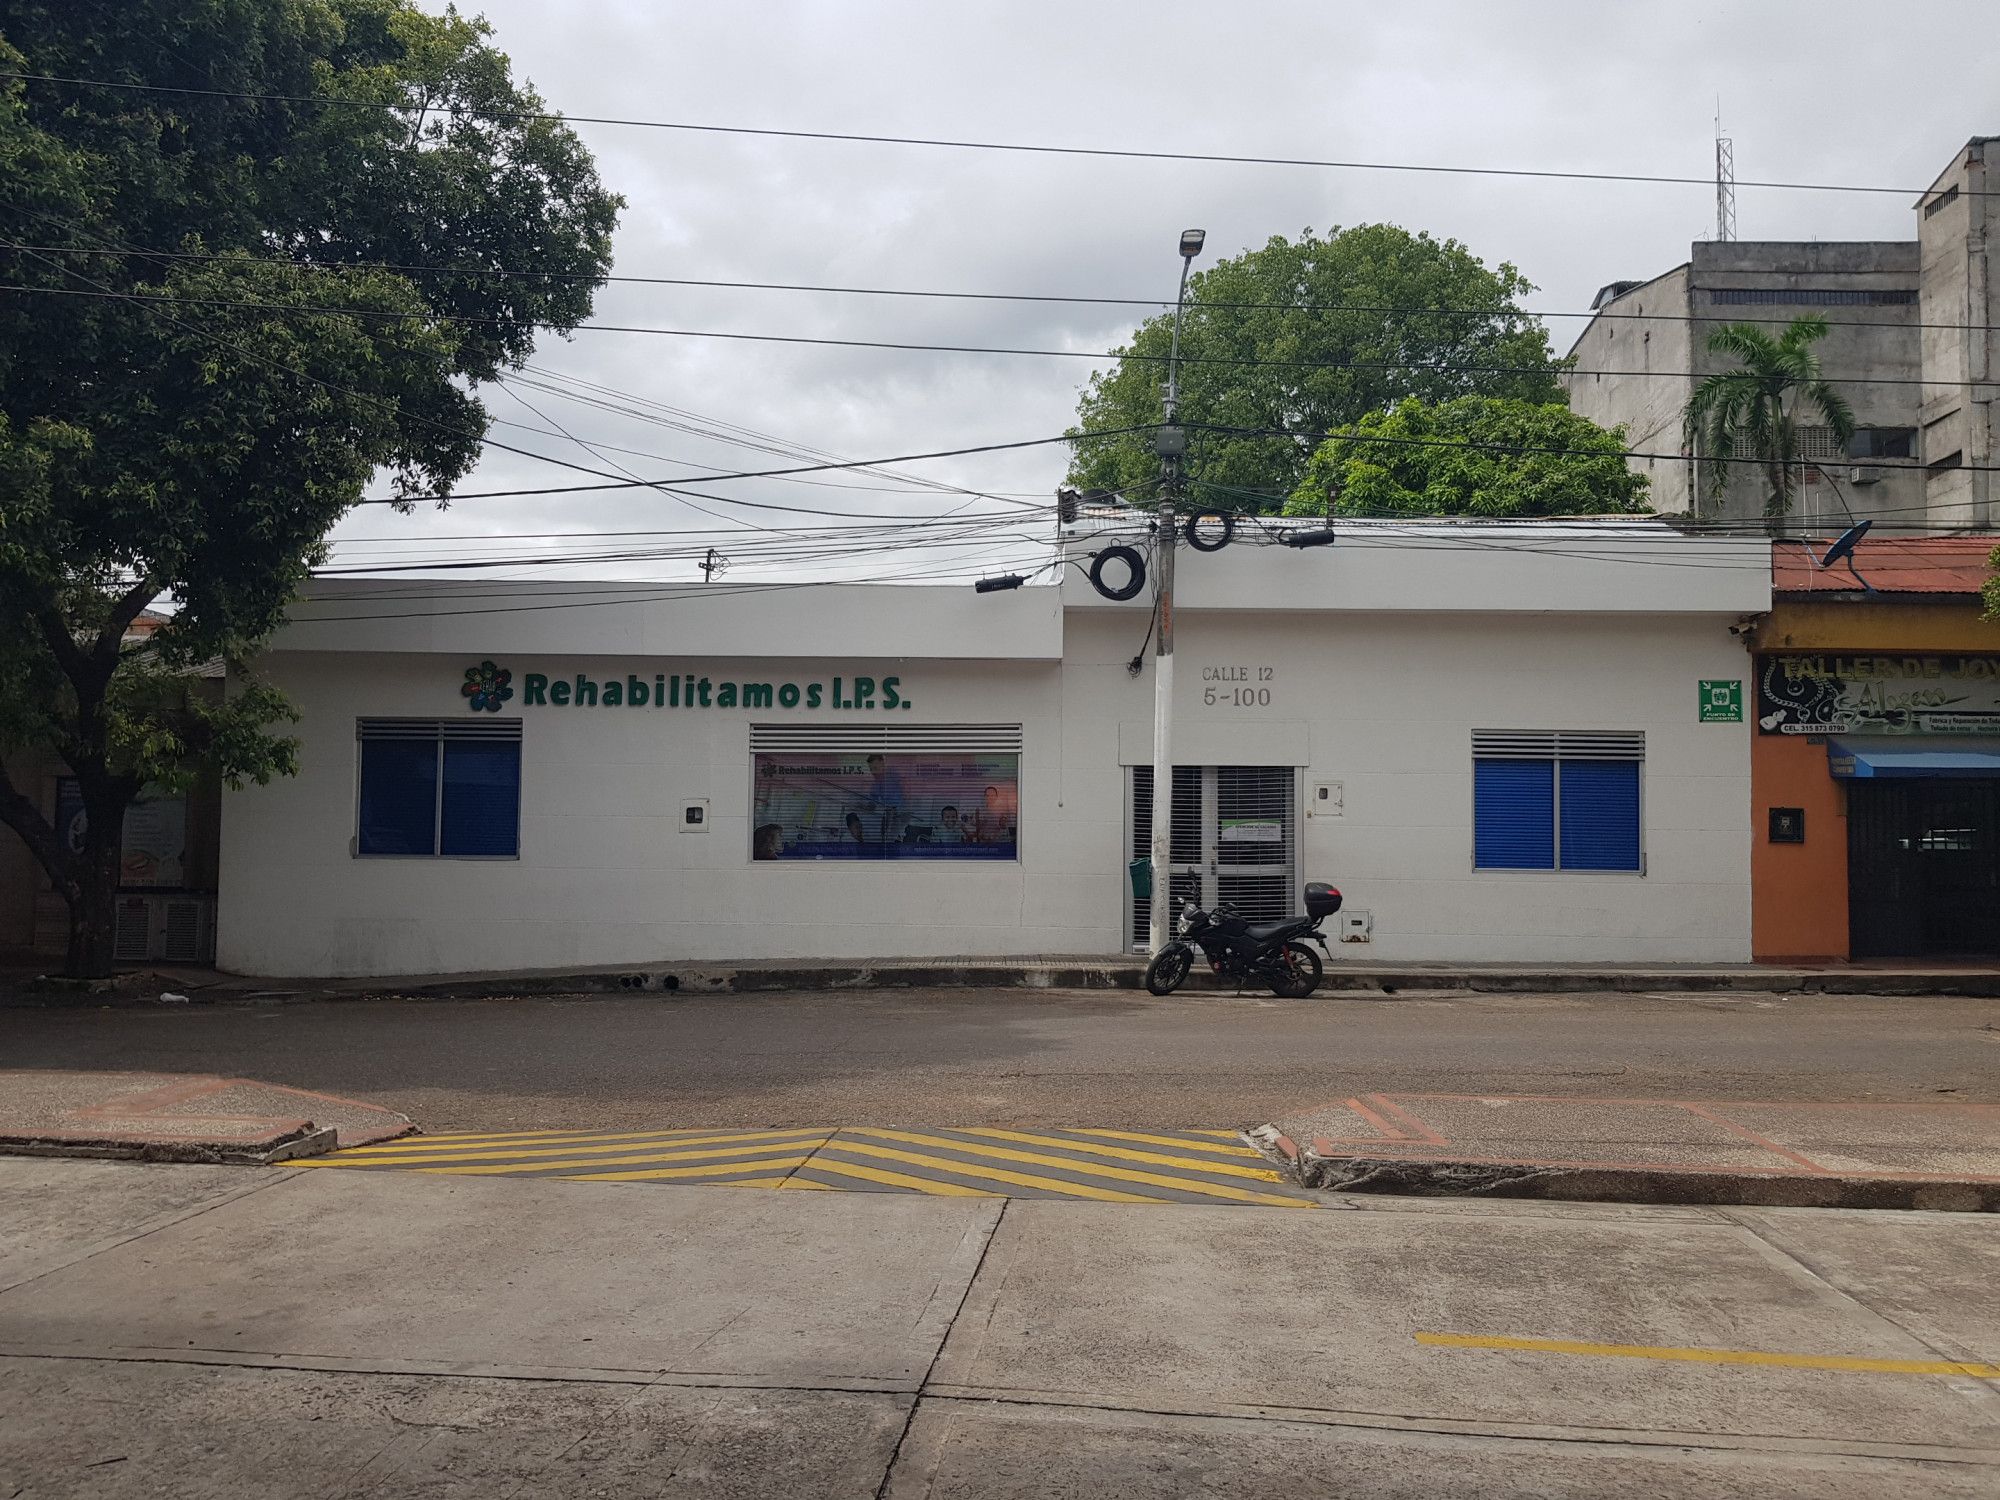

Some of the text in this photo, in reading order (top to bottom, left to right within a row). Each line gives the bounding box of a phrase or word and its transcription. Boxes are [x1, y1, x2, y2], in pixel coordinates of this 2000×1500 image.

[1202, 666, 1274, 681] CALLE 12
[1778, 657, 1898, 679] TALLER
[1902, 658, 1941, 679] DE
[523, 673, 912, 709] Rehabilitamos I.P.S.
[1203, 686, 1271, 706] 5-100
[778, 765, 841, 775] Rehabilitamos
